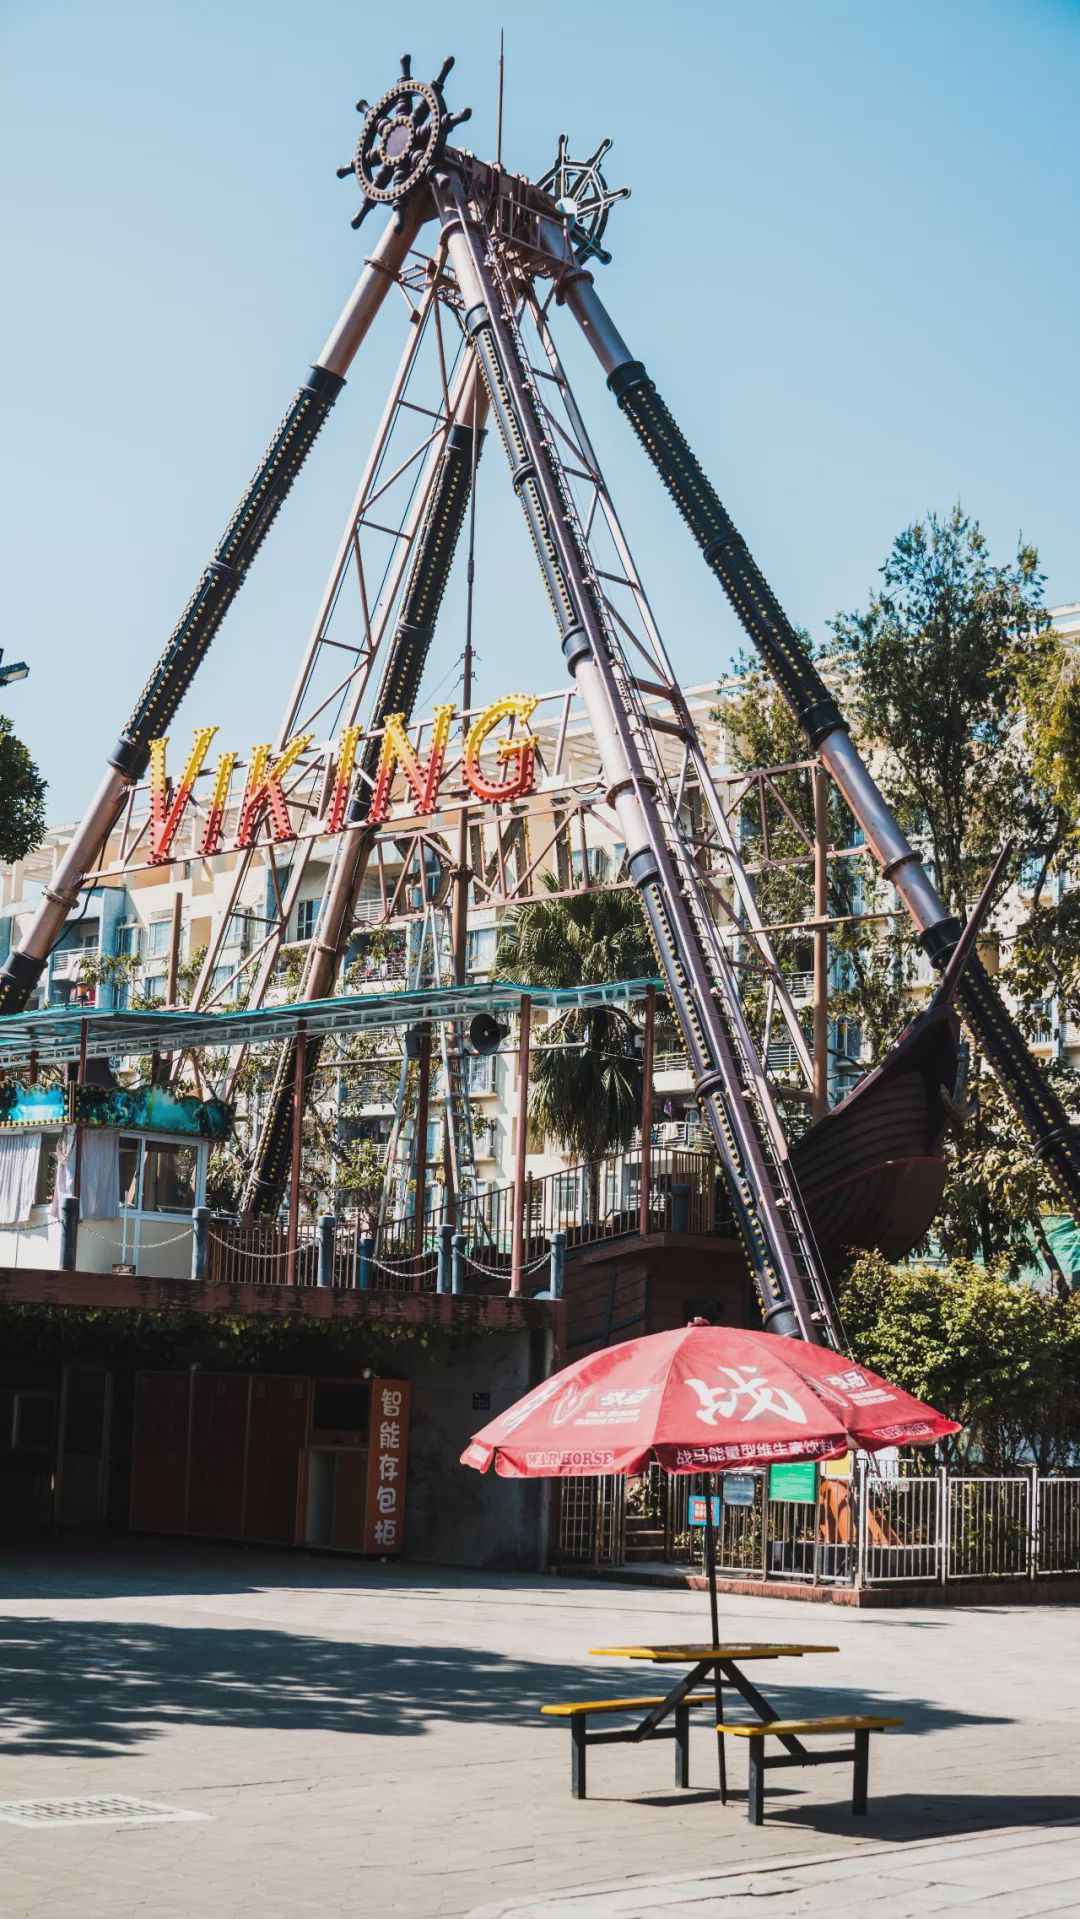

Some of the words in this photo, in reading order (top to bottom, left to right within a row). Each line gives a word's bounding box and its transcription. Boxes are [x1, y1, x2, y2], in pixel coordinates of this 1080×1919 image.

[147, 693, 541, 866] VIKING
[684, 1365, 808, 1426] 战
[374, 1388, 402, 1546] 智能存包柜
[528, 1452, 558, 1466] WAR
[560, 1451, 613, 1465] HORSE
[676, 1440, 836, 1466] 战马能量型维生素饮料
